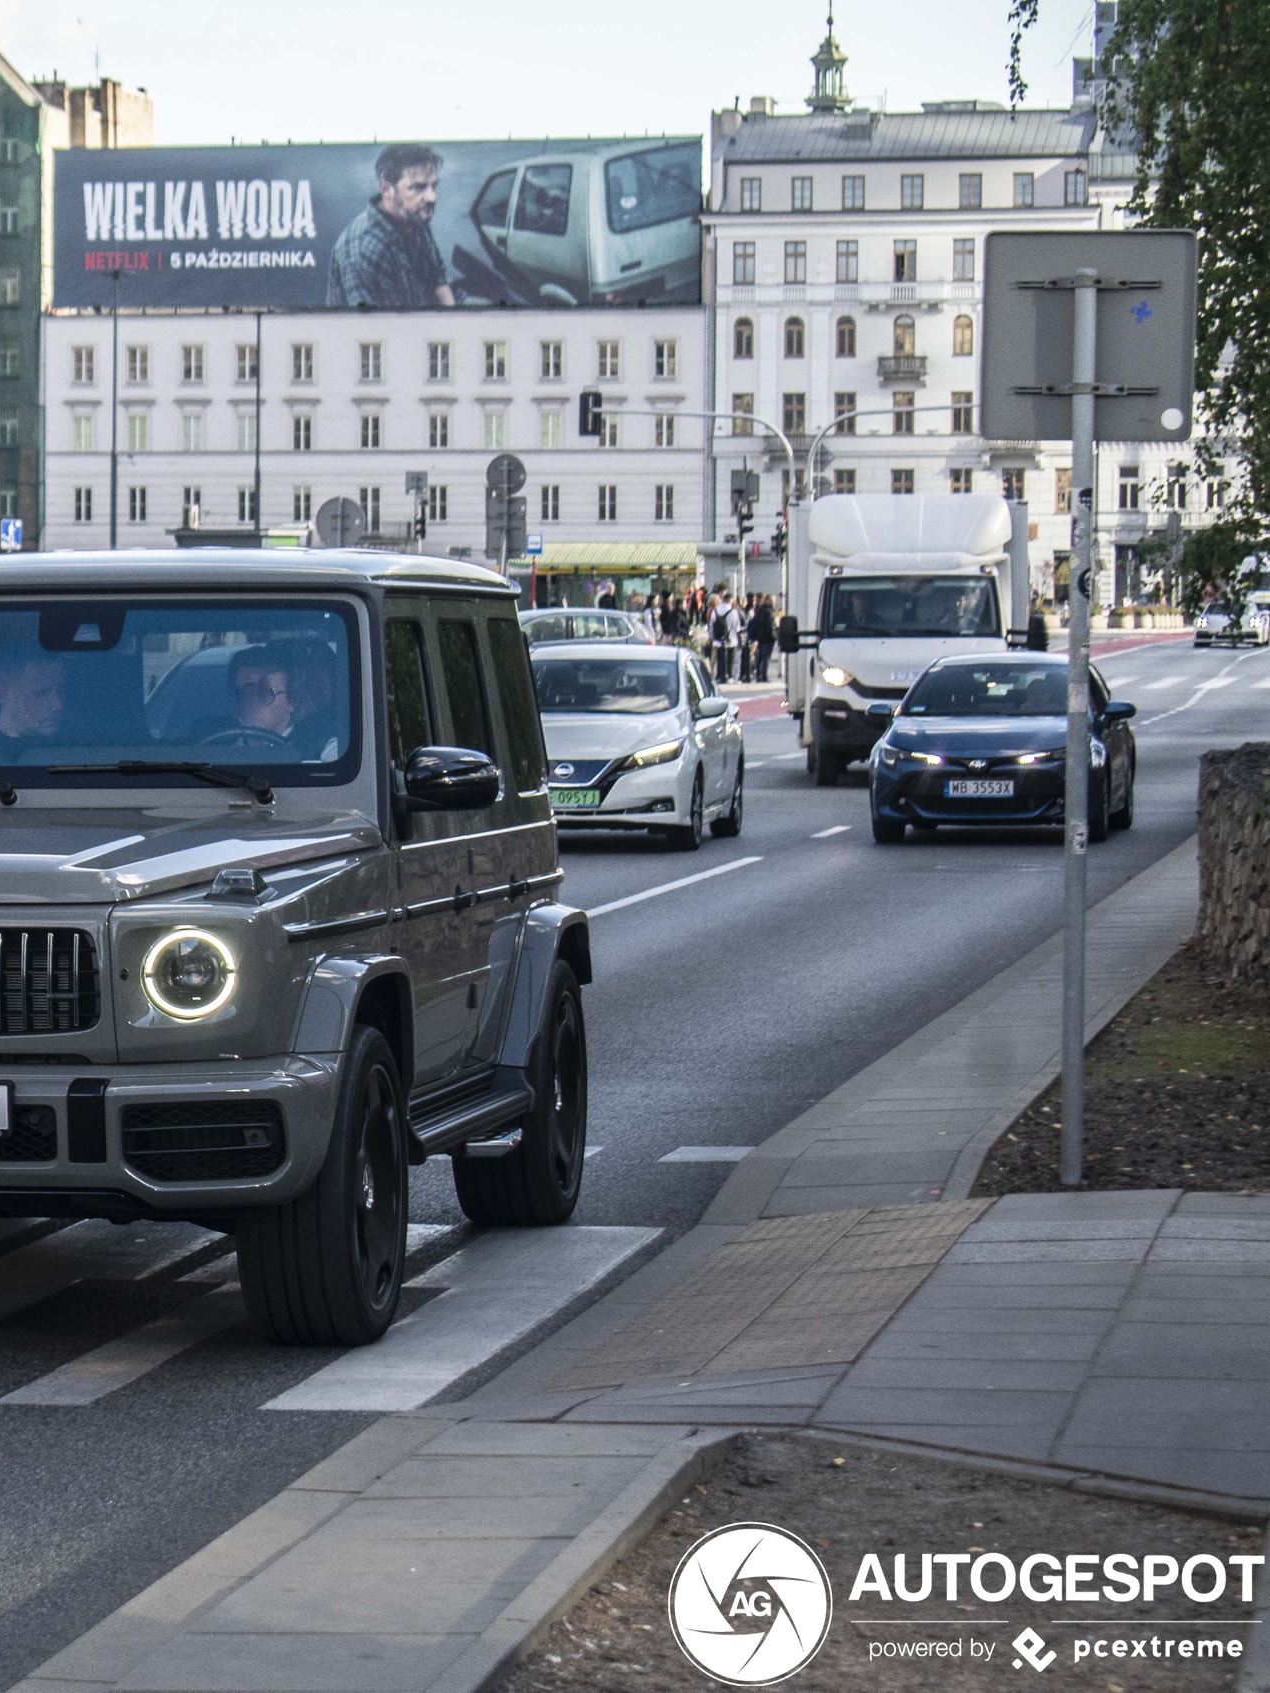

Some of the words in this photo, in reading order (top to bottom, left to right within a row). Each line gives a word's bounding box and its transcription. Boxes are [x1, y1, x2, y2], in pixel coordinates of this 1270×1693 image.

[83, 180, 209, 241] WIELKA
[215, 179, 317, 240] WODA
[85, 251, 149, 270] NETFLIX
[170, 252, 181, 269] 5
[185, 248, 317, 269] PAŹDZIERNIKA
[952, 781, 968, 794] WB
[972, 781, 1011, 794] 3553X
